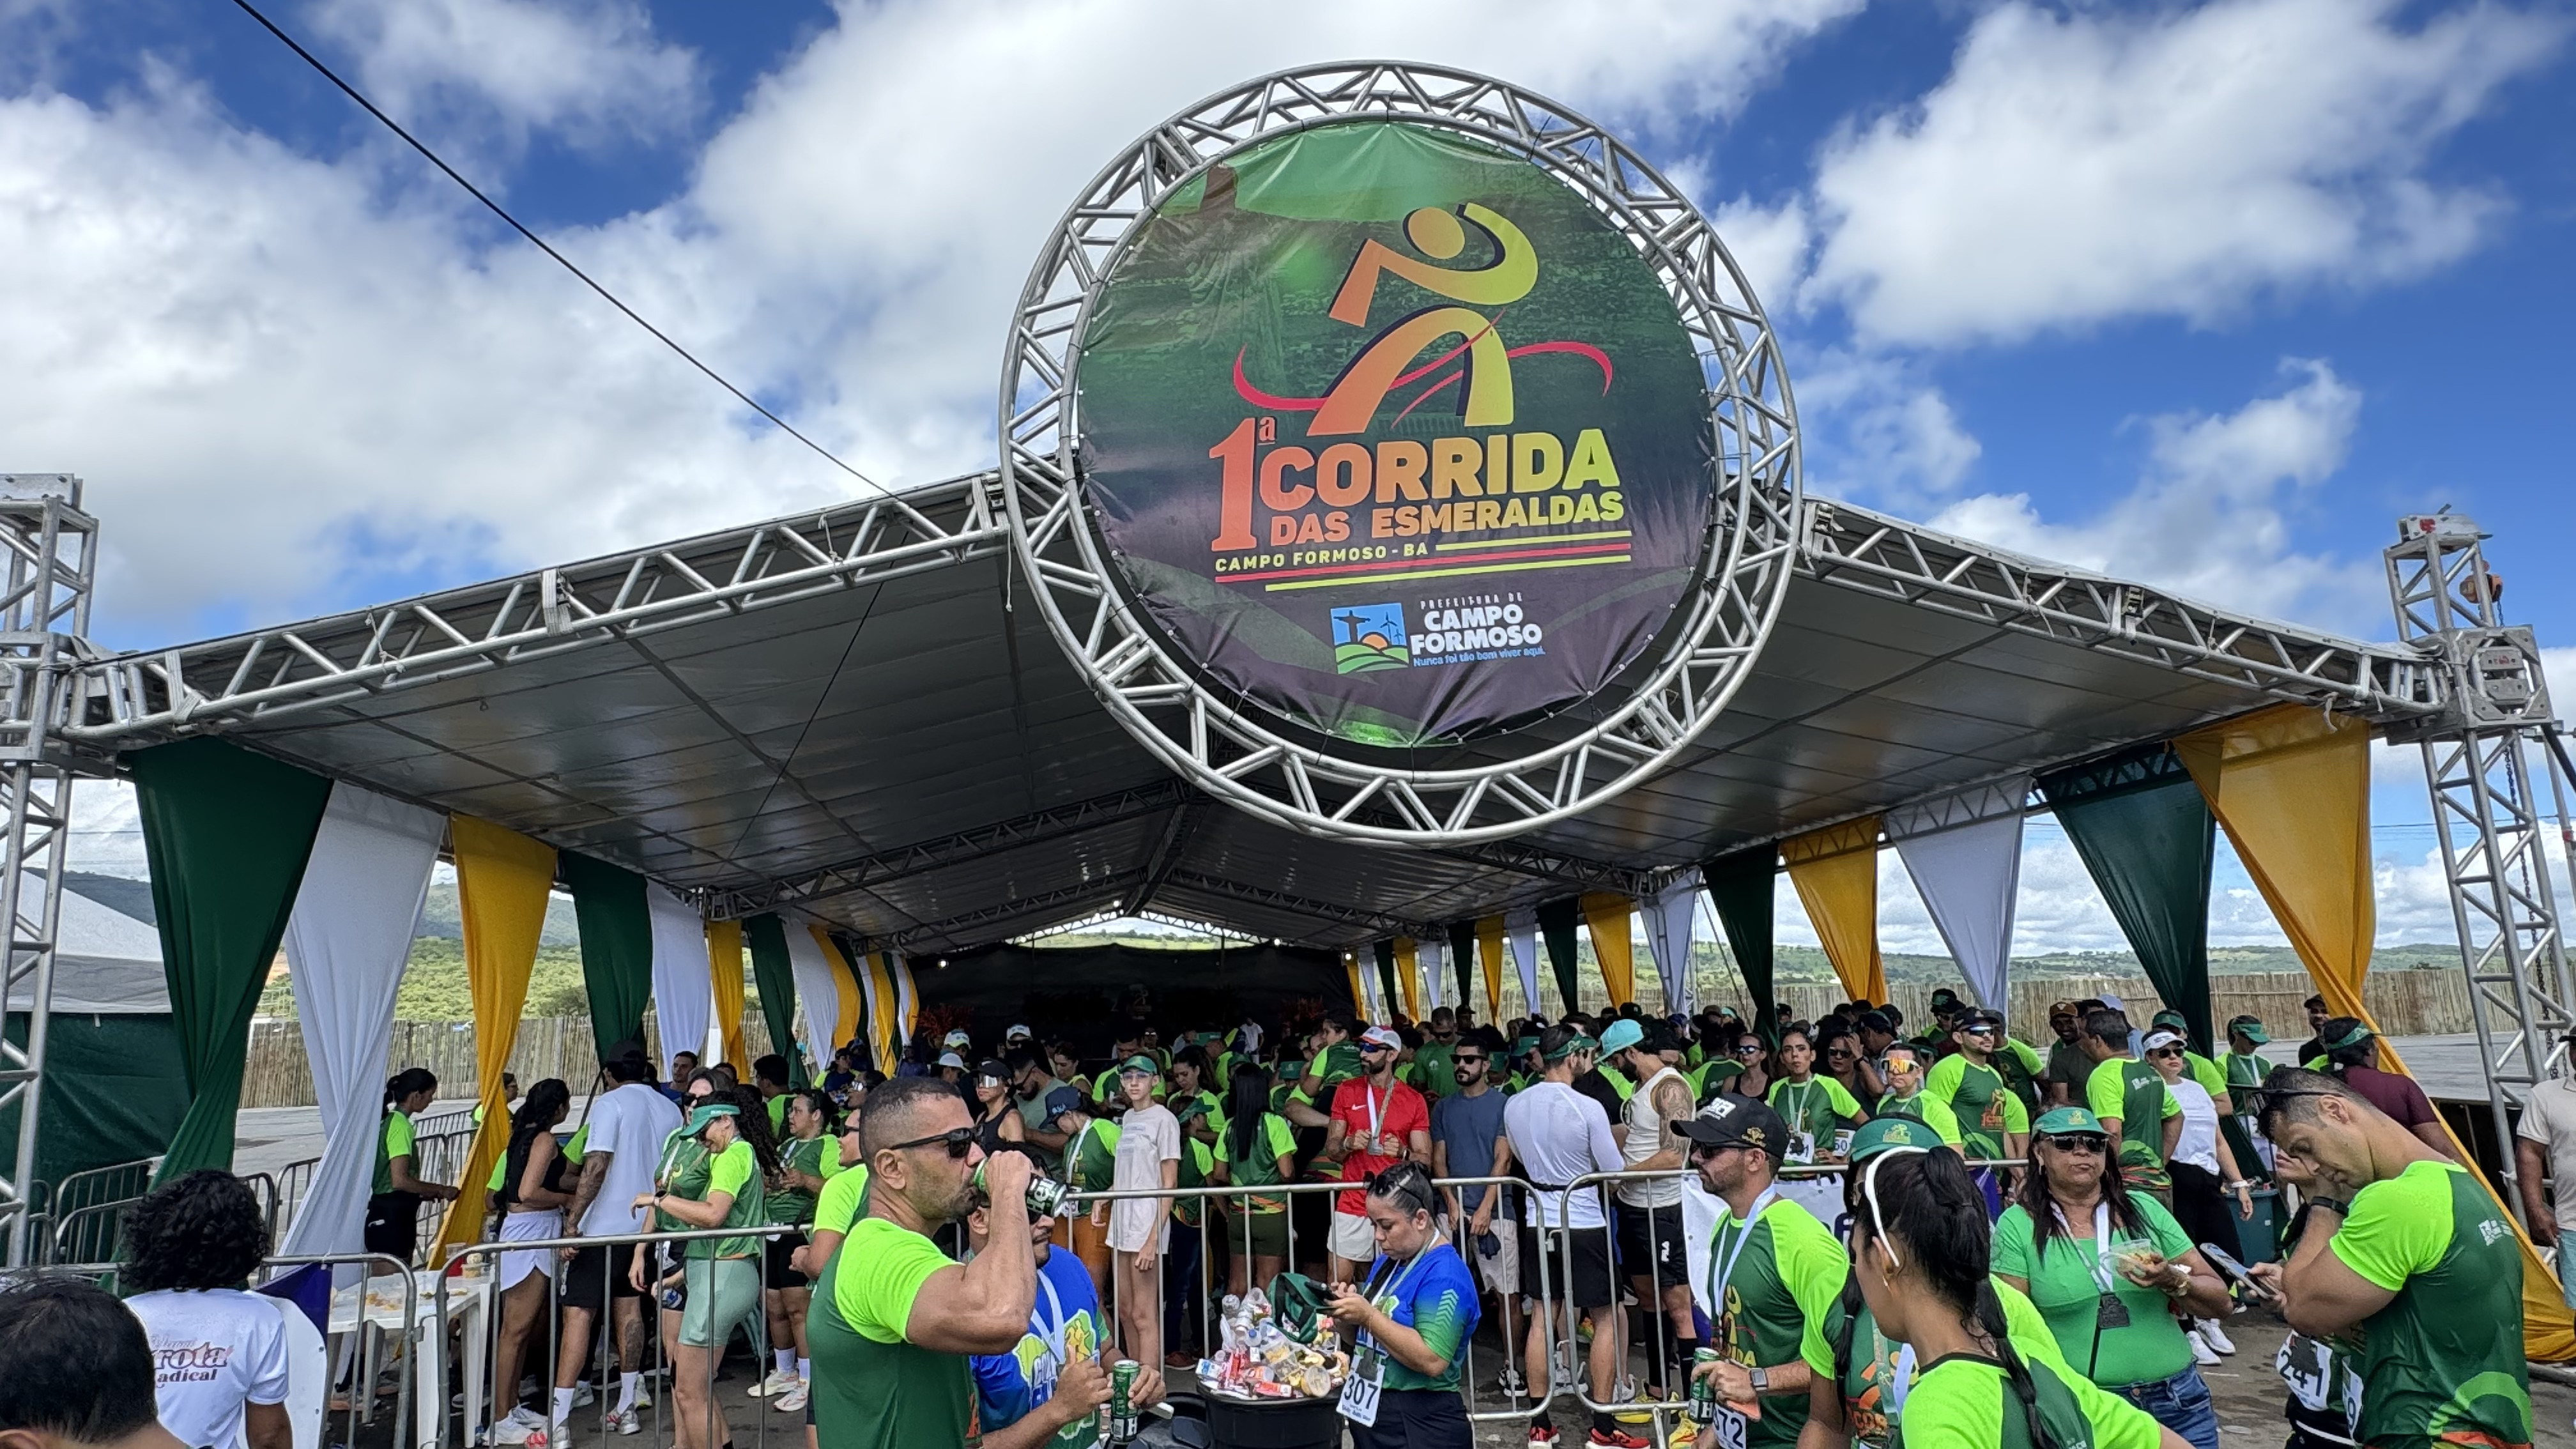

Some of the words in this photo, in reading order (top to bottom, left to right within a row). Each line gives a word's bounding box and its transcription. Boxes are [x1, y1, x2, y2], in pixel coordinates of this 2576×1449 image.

[1259, 429, 1620, 511] CORRIDA
[1270, 512, 1351, 547] DAS
[1371, 491, 1624, 538] ESMERALDAS
[1215, 553, 1285, 572] CAMPO
[1293, 546, 1386, 566] FORMOSO
[1403, 542, 1428, 557] BA
[1420, 594, 1500, 610] PREFEITURA
[1508, 592, 1523, 602] DE
[1424, 604, 1524, 631] CAMPO
[1410, 624, 1542, 655] FORMOSO
[1413, 654, 1444, 667] Nunca
[1445, 653, 1458, 664] foi
[156, 1368, 218, 1388] adical
[1344, 1374, 1379, 1410] 307
